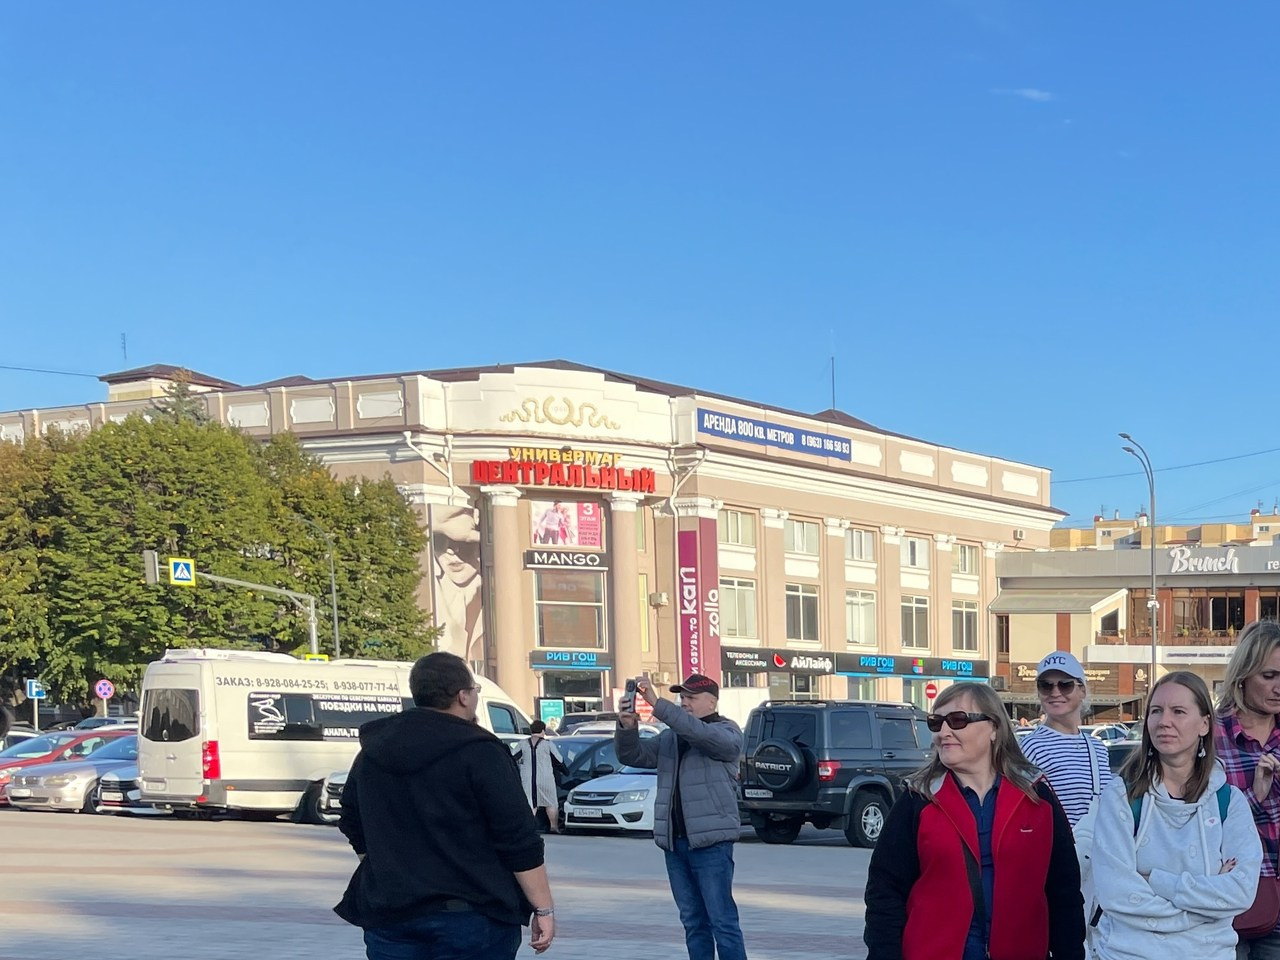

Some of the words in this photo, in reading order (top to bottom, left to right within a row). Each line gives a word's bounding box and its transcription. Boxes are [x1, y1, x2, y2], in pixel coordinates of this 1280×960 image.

[703, 413, 737, 435] АРЕНДА
[738, 420, 753, 437] 800
[754, 425, 766, 439] КВ.
[767, 428, 794, 445] МЕТРОВ
[801, 434, 806, 446] 8
[807, 435, 822, 449] (963)
[842, 443, 850, 454] 93
[509, 447, 623, 466] УНИВЕРМАГ
[473, 460, 656, 493] ЦЕНТРАЛЬНЫЙ
[583, 503, 594, 515] 3
[533, 552, 600, 566] MANGO
[1169, 547, 1239, 574] Brunch
[703, 589, 720, 637] zolla
[546, 652, 571, 661] РИВ
[572, 653, 597, 661] ГОШ
[860, 657, 877, 666] РИВ
[878, 657, 894, 667] ГОШ
[1043, 655, 1066, 667] NYC
[791, 657, 832, 672] АйЛайф
[942, 661, 957, 670] РИВ
[958, 662, 972, 671] ГОШ
[216, 676, 254, 687] ЗАКАЗ:
[256, 678, 328, 690] 8-928-084-25-25;
[333, 681, 399, 692] 8-938-077-77-44
[320, 701, 363, 713] ПОЕЗДКИ
[363, 703, 377, 712] НА
[323, 728, 351, 738] АНАПА,
[755, 761, 792, 771] PATRIOT
